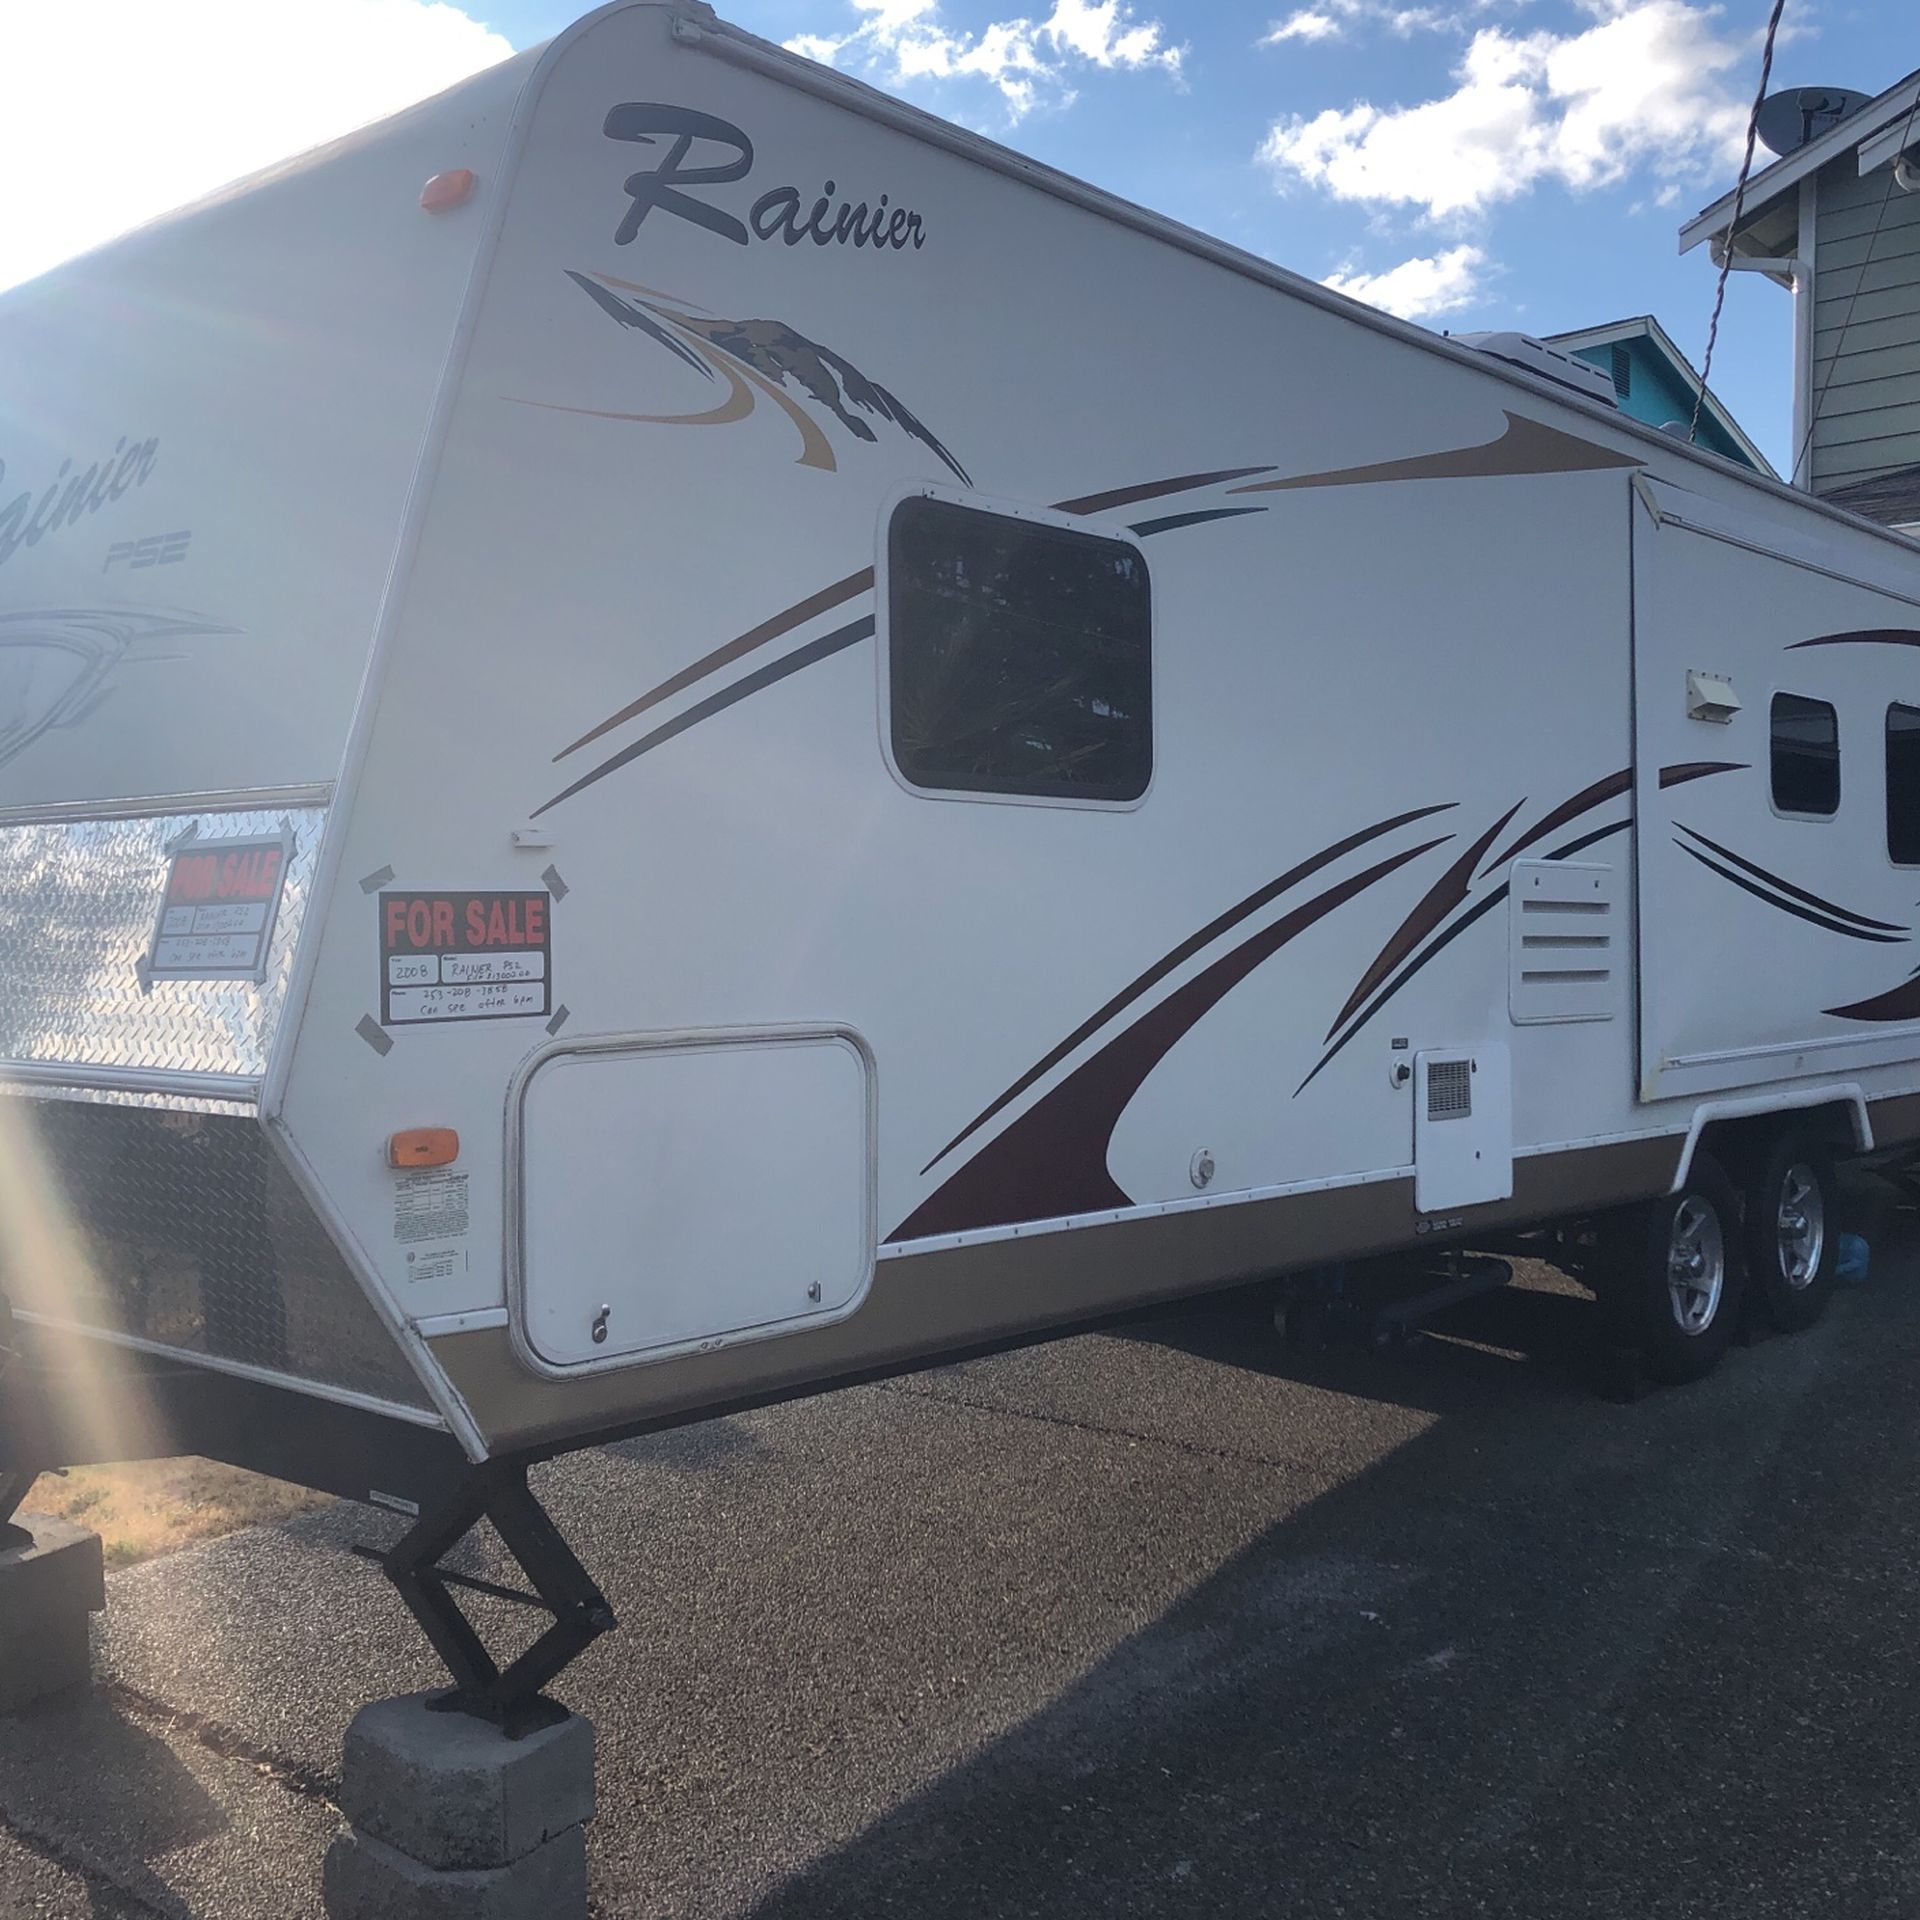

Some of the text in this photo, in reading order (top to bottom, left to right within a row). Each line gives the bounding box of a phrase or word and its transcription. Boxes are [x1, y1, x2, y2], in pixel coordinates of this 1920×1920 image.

[603, 102, 926, 250] Rainier
[216, 850, 282, 897] SALE
[387, 899, 546, 948] FOR SALE
[396, 964, 429, 979] 2008
